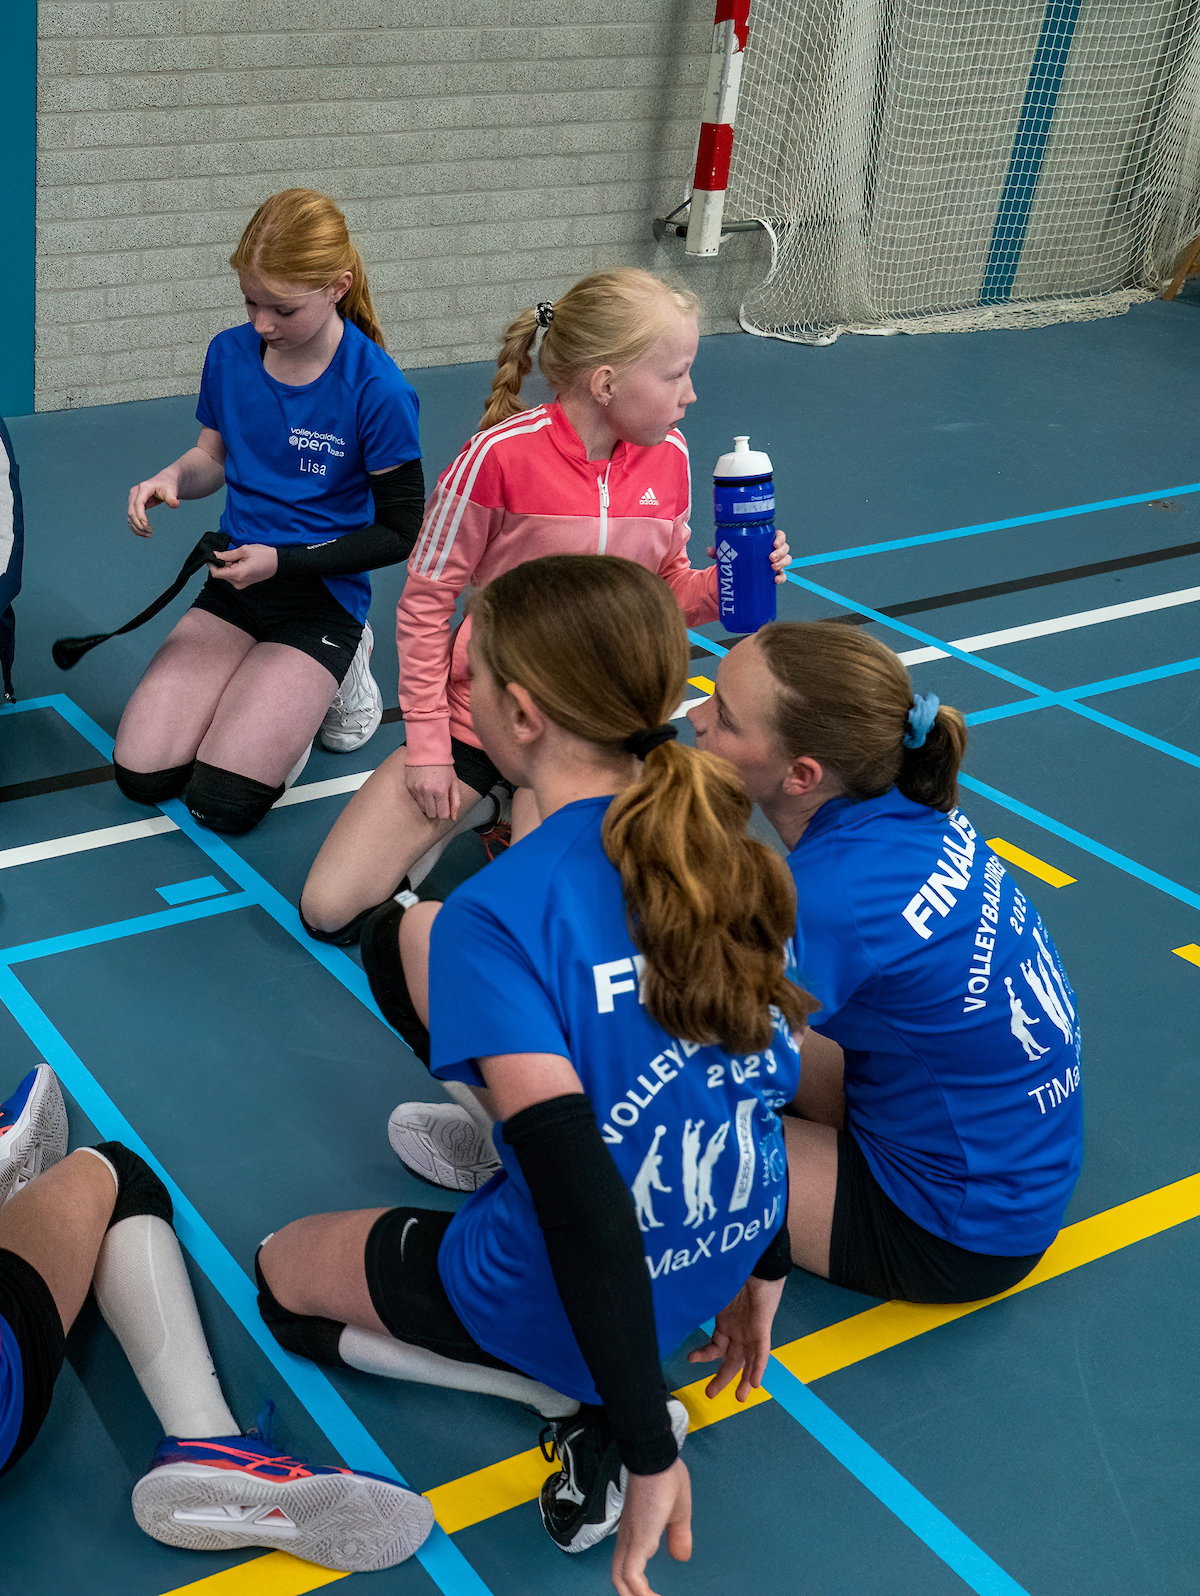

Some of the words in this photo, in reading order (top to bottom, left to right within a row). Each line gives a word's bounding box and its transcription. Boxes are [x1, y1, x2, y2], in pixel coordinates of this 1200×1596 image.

[299, 457, 327, 476] Lisa
[901, 808, 977, 940] FINALIS
[963, 855, 1007, 1013] VOLLEYBALDIRE
[706, 1049, 777, 1089] 2023
[1027, 1065, 1081, 1115] TiMa
